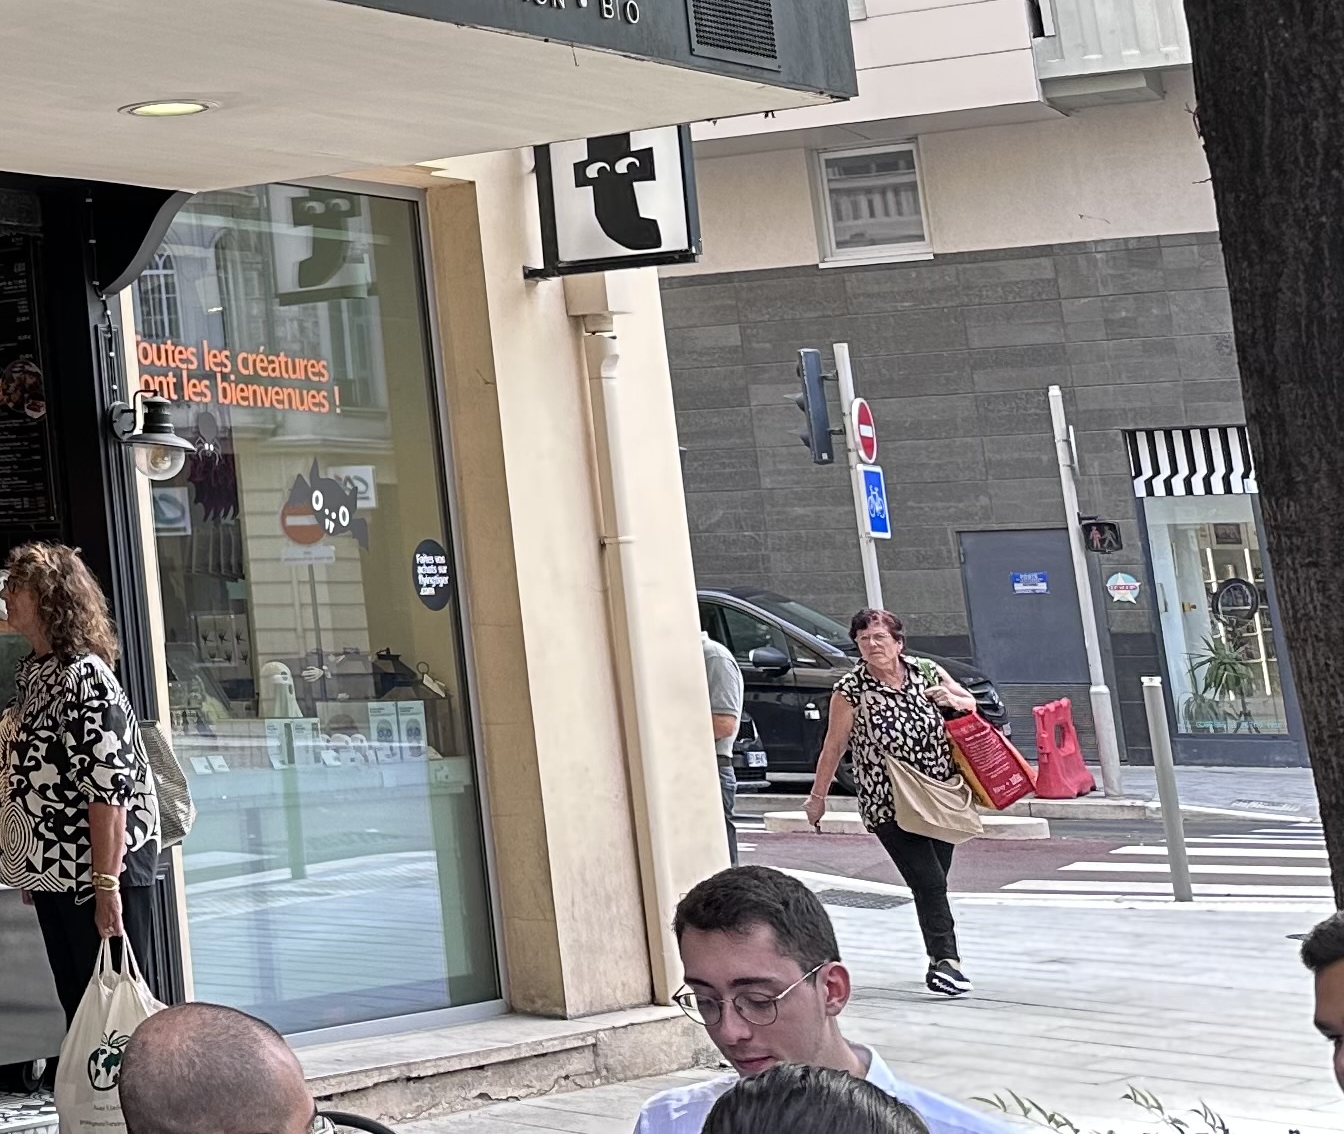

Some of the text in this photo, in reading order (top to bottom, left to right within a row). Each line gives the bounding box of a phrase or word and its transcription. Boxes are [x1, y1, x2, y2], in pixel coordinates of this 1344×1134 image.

[202, 339, 232, 374] les
[237, 345, 330, 383] créatures
[139, 371, 178, 401] ont
[182, 369, 212, 403] les
[216, 372, 330, 413] bienvenues
